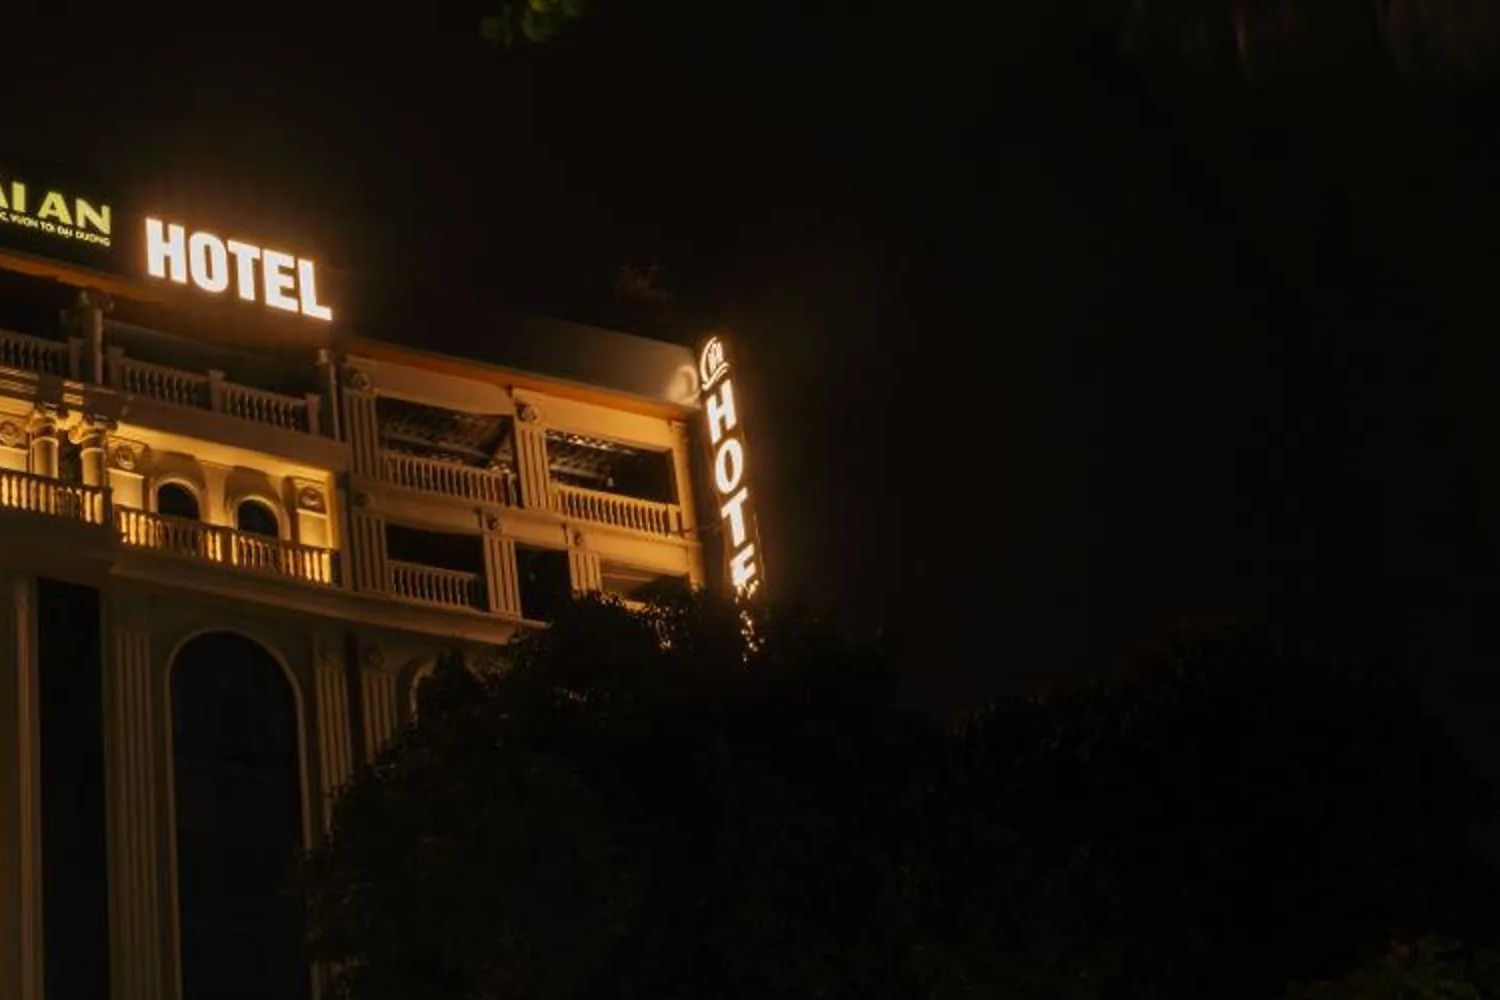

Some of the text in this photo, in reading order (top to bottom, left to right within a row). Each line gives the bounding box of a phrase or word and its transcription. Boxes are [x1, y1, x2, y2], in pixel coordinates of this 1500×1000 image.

[37, 191, 112, 235] AN
[145, 217, 333, 321] HOTEL
[706, 379, 761, 606] HOTE
